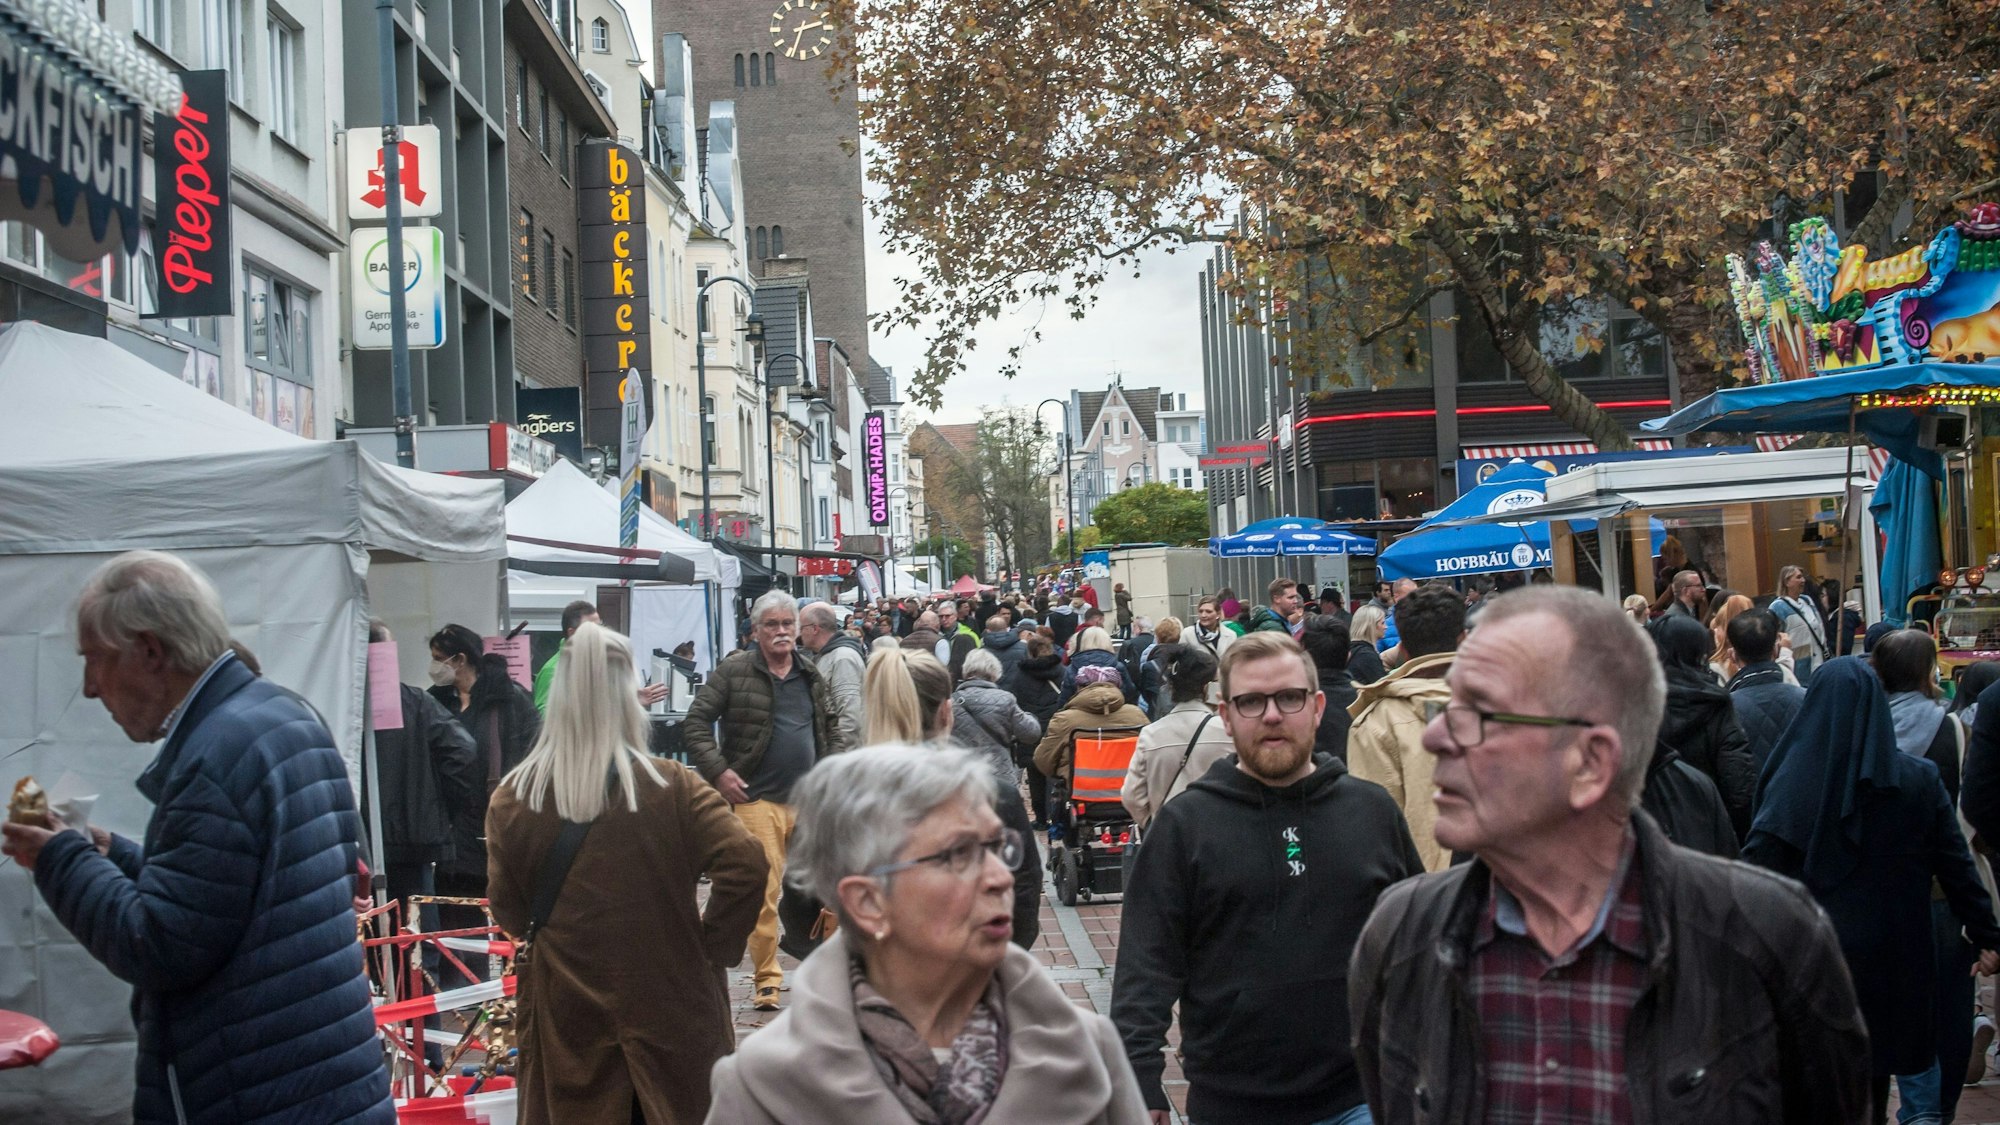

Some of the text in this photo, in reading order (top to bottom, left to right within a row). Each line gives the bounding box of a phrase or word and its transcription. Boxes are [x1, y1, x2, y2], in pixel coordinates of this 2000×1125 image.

[163, 92, 220, 294] Pieper
[369, 261, 418, 272] BAER
[365, 309, 417, 320] Germia
[369, 320, 420, 333] Apoke
[517, 420, 575, 437] ngbers
[1435, 550, 1509, 573] HOFBRÄU
